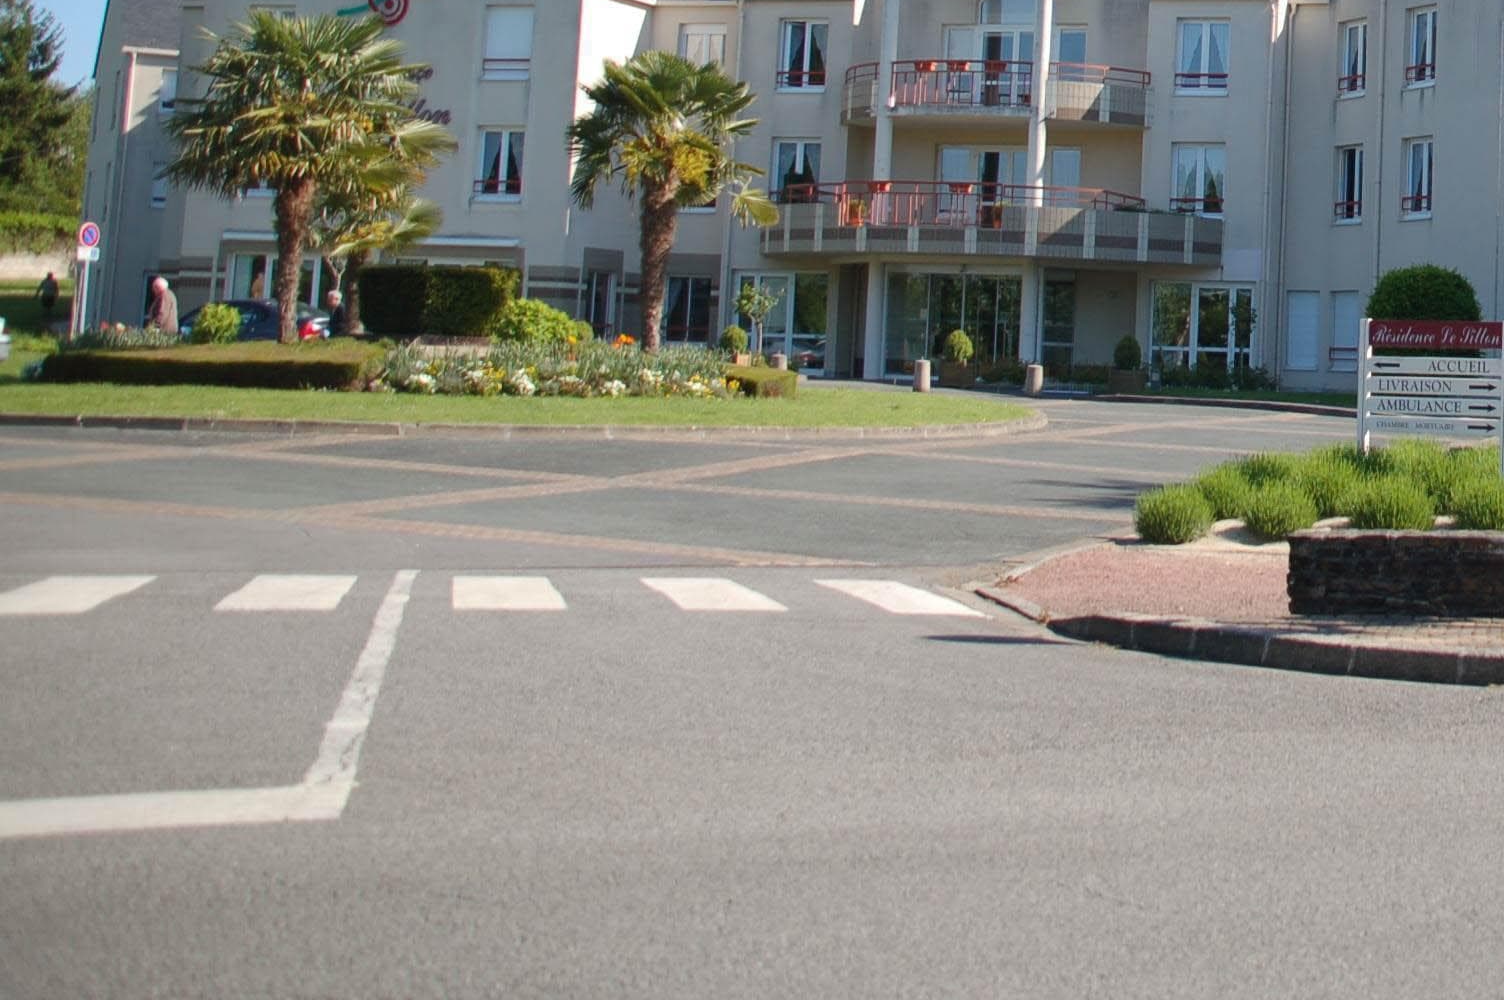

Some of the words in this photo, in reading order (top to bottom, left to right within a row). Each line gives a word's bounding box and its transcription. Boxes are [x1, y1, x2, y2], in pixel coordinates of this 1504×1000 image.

[1372, 325, 1436, 344] Résidence
[1441, 326, 1457, 344] Le
[1428, 360, 1490, 374] ACCUEIL
[1378, 379, 1452, 393] LIVRAISON
[1377, 399, 1462, 413] AMBULANCE
